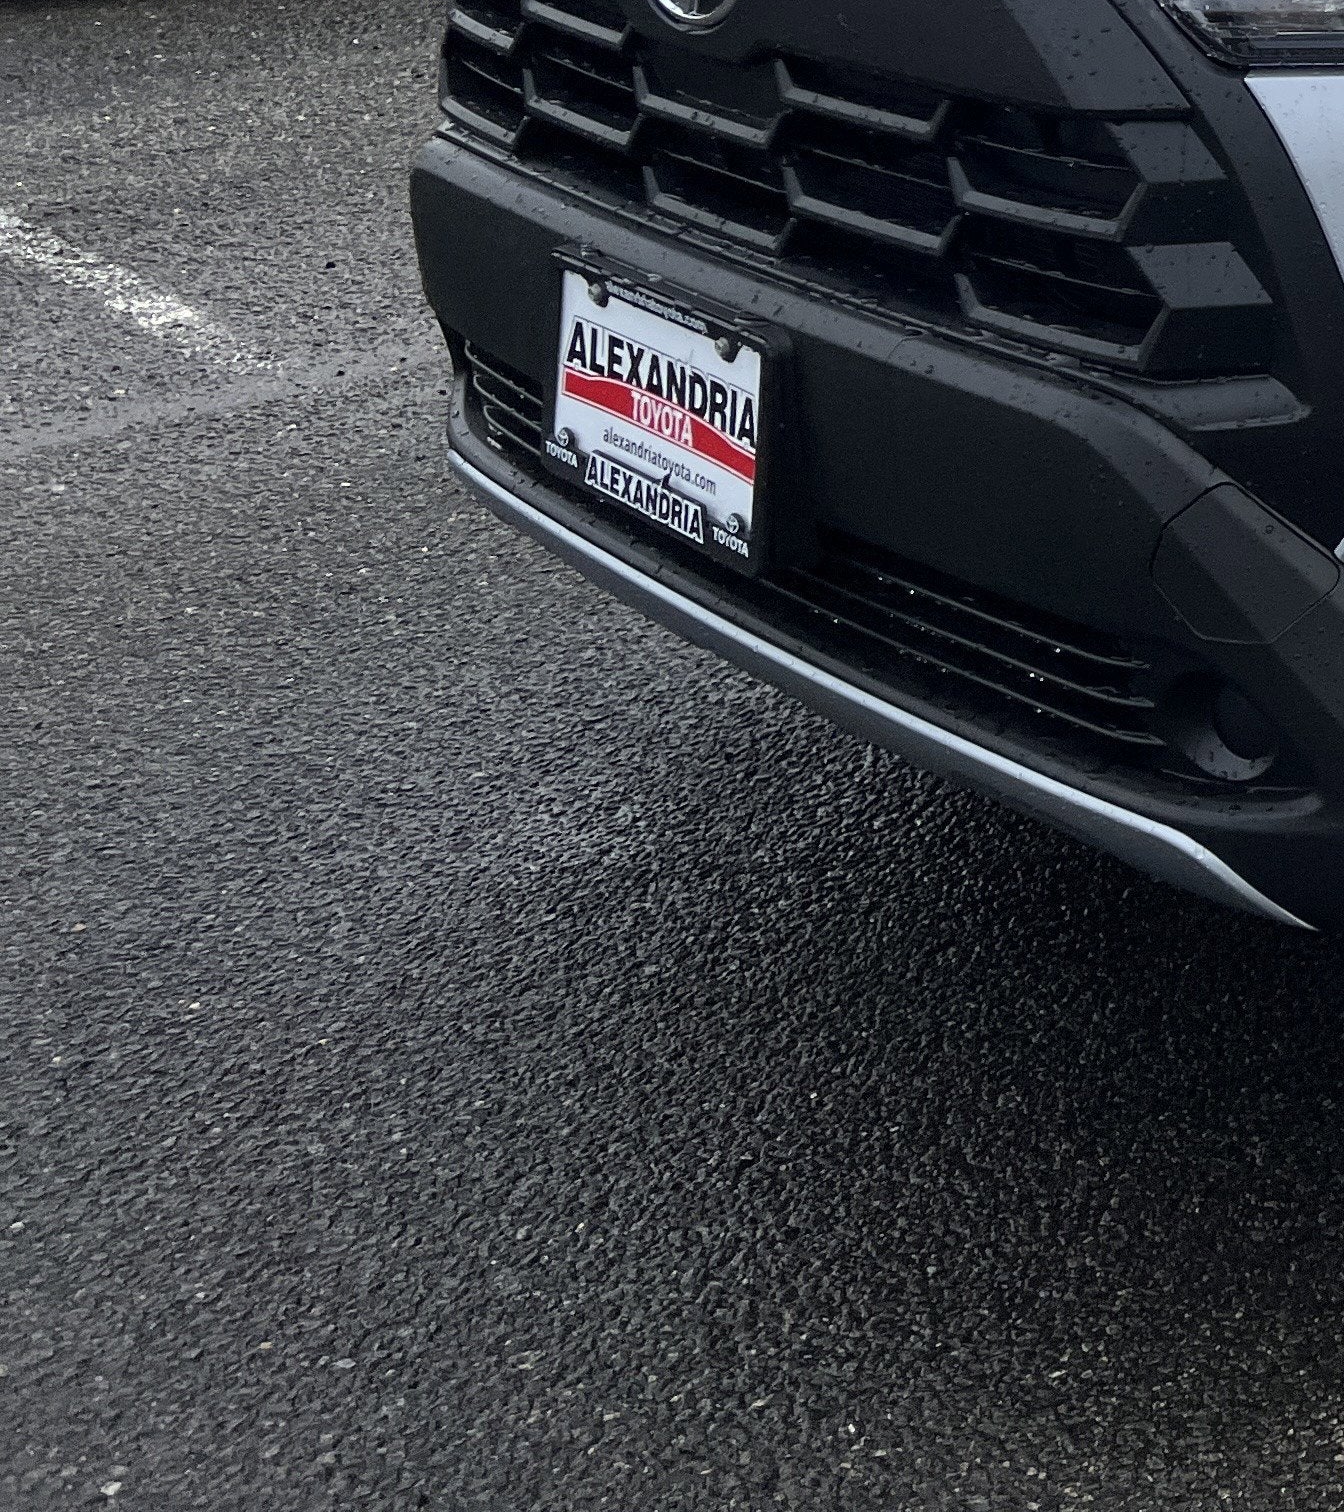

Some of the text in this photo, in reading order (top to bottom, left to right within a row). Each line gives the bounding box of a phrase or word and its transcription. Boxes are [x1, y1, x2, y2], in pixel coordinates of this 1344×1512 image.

[566, 320, 758, 447] ALEXANDRIA
[630, 390, 695, 449] TOYOTA
[545, 440, 579, 468] TOYOTA
[602, 427, 717, 496] alexandriatoyota.com
[586, 454, 704, 543] ALEXANDRIA
[712, 525, 749, 558] TOYOTA
